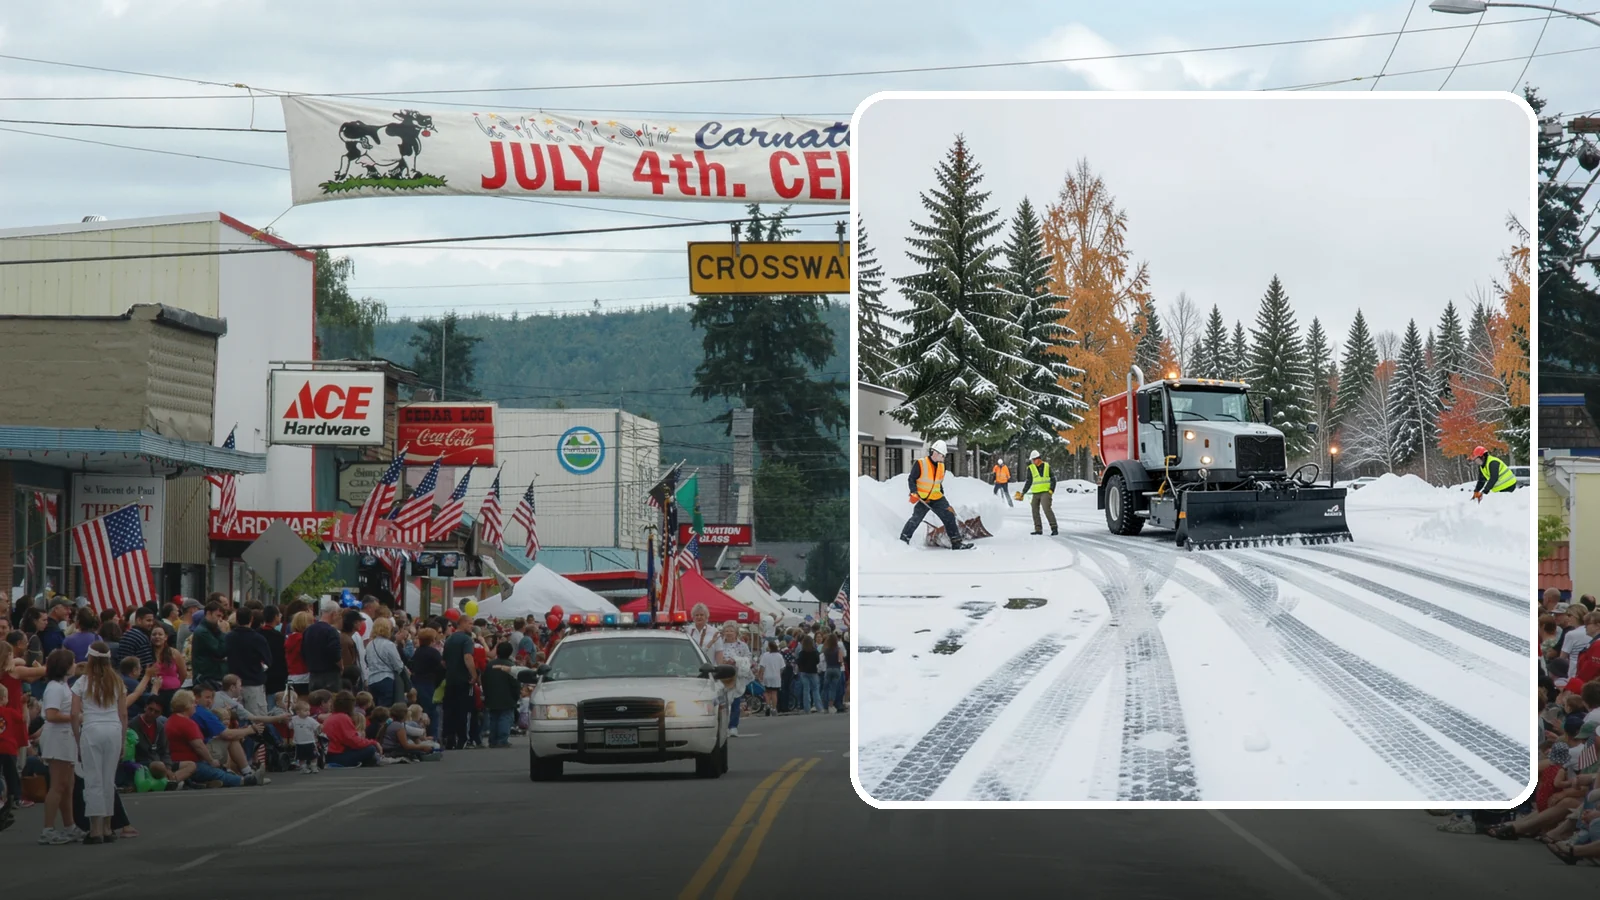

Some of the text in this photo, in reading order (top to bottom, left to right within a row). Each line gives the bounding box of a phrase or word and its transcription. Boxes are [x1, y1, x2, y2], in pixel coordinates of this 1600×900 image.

[481, 141, 605, 193] JULY
[632, 150, 746, 198] 4th.
[697, 254, 851, 280] CROSSWA
[283, 380, 373, 420] ACE
[406, 409, 453, 422] CEDAR
[283, 420, 371, 437] Hardware
[416, 428, 477, 447] Coca-Cola
[353, 467, 385, 480] Simpl
[95, 485, 124, 495] Vincent
[126, 486, 136, 495] de
[137, 486, 155, 496] Paul
[81, 503, 154, 523] THT
[213, 516, 331, 536] HARDARE
[688, 526, 742, 535] CRNATION
[699, 535, 730, 544] GLASS
